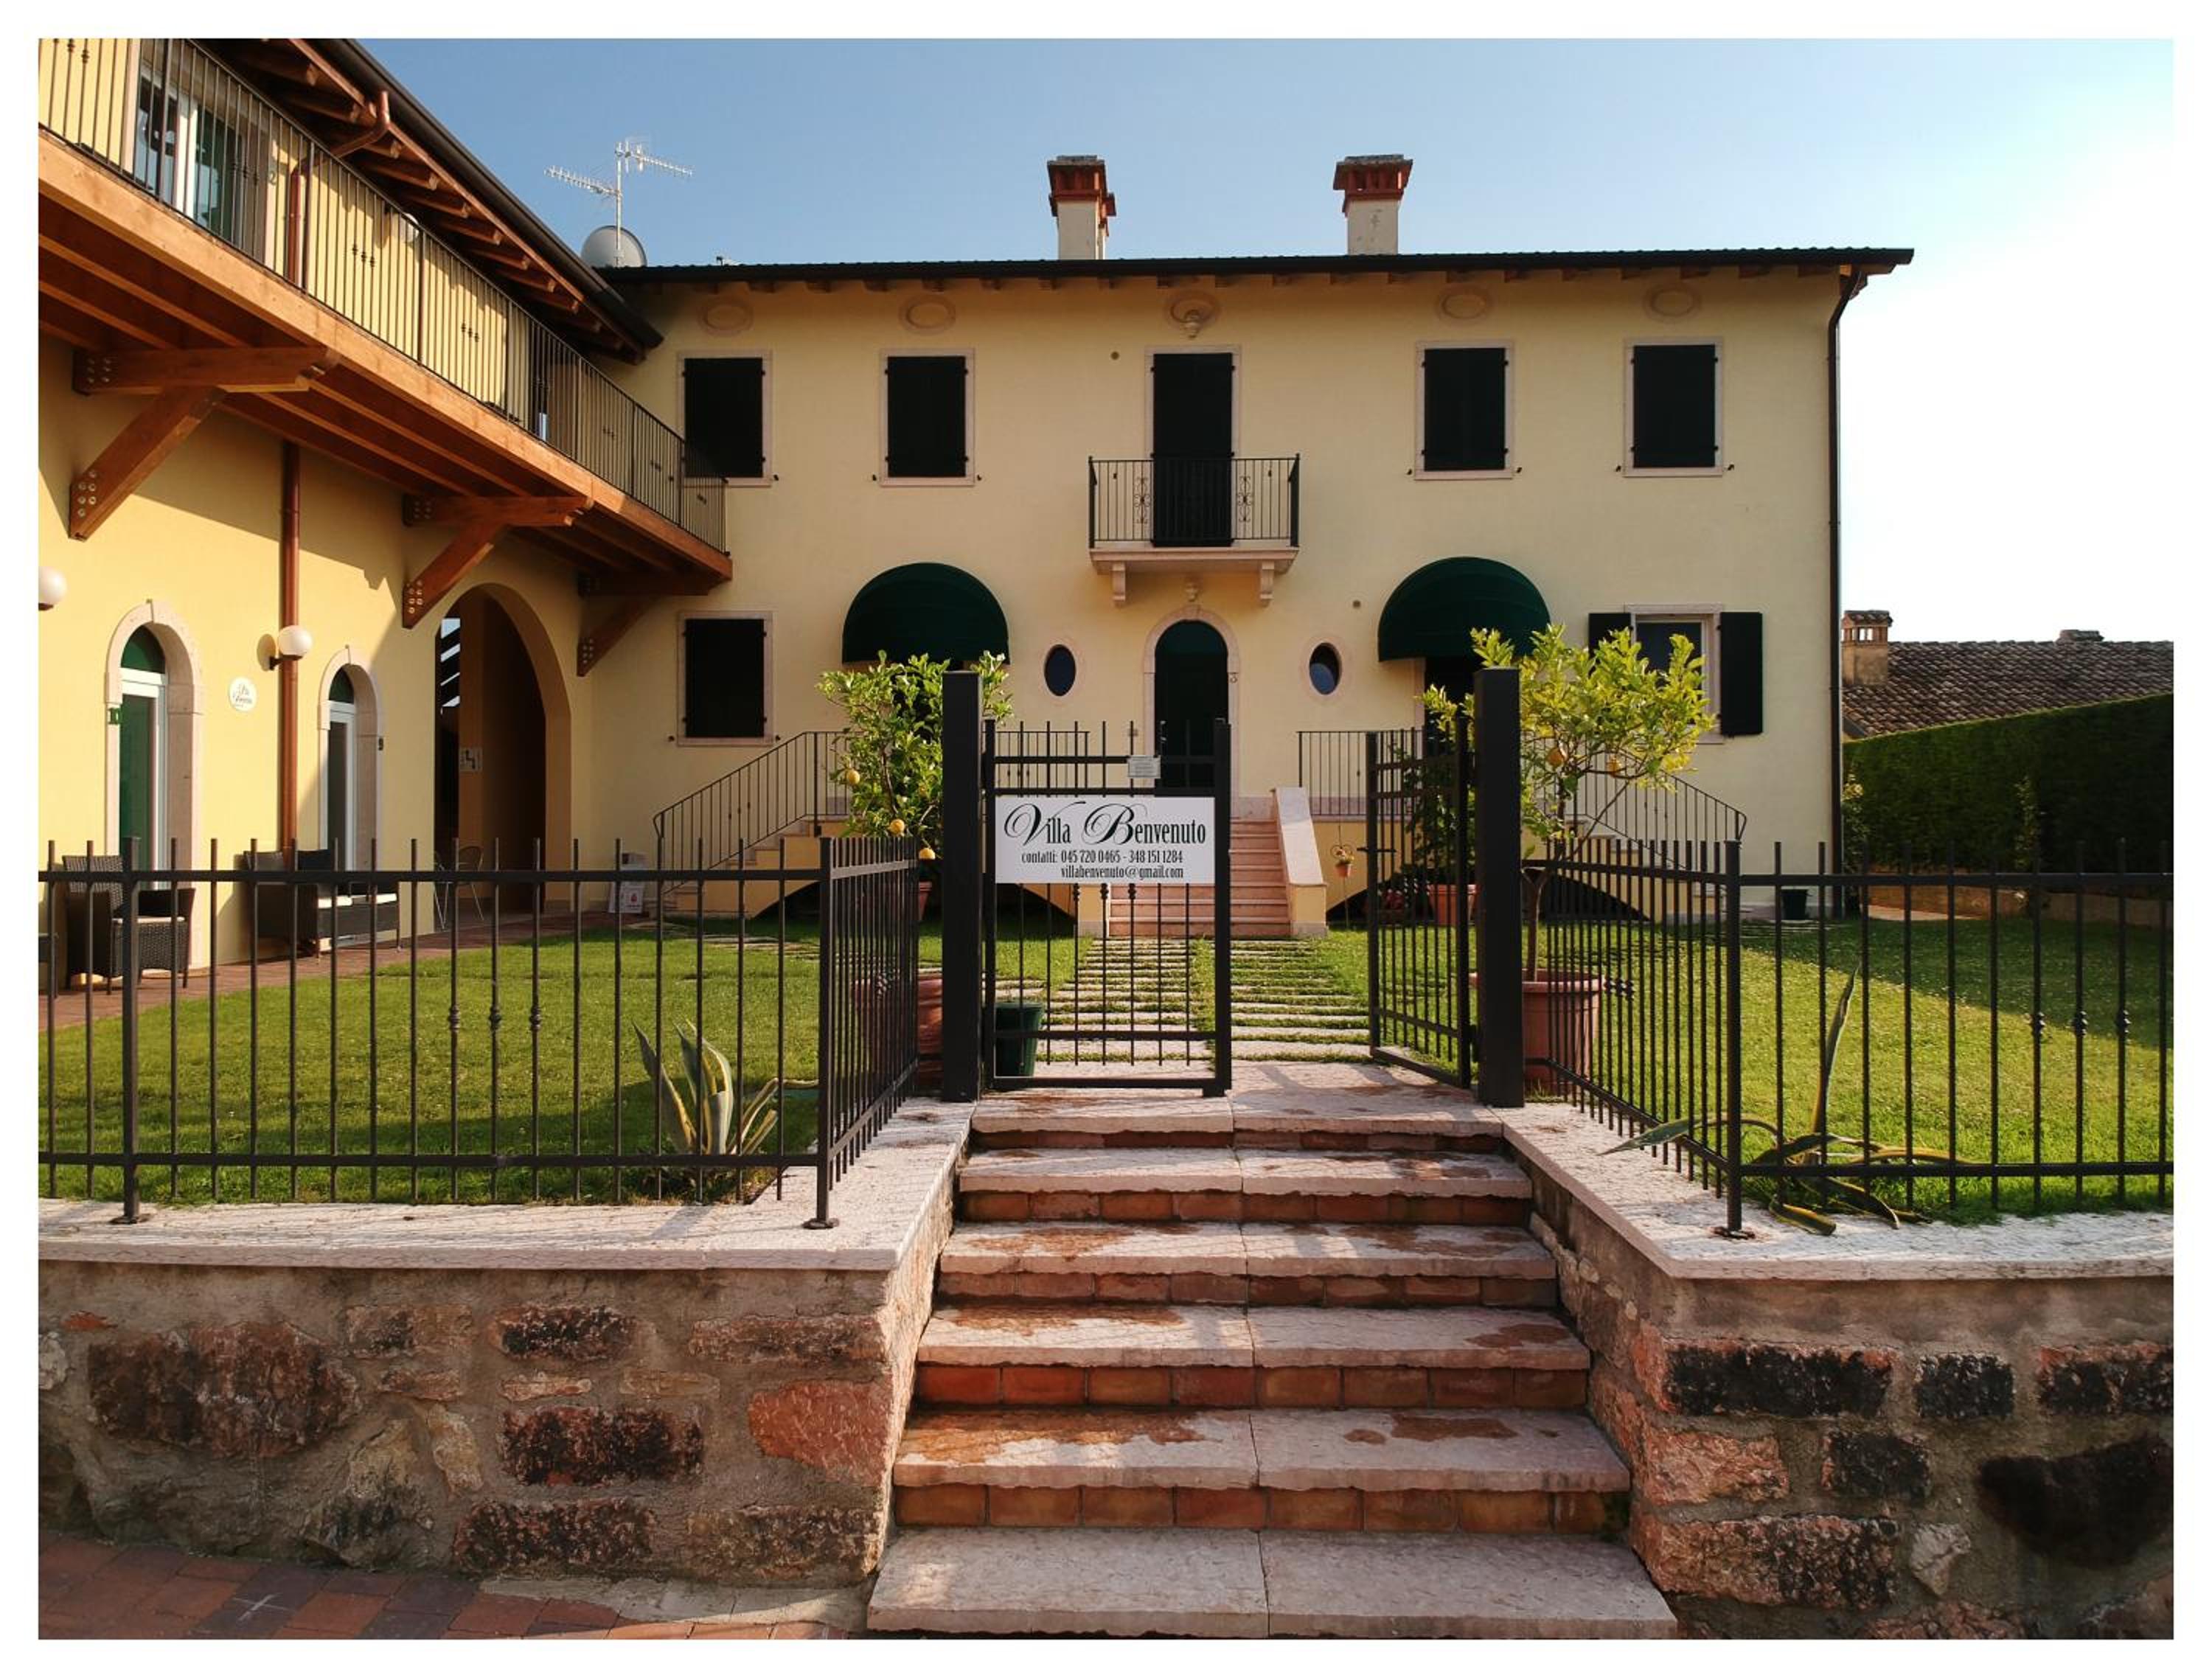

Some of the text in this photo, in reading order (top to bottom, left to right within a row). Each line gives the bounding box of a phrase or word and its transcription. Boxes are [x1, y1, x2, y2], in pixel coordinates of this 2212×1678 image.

[1004, 801, 1206, 846] Villa Benvenuto
[1021, 850, 1057, 863] contatti:
[1061, 849, 1077, 863] 045
[1079, 849, 1096, 863] 720
[1098, 849, 1121, 863] 0465
[1128, 849, 1146, 863] 348
[1147, 849, 1160, 863] 151
[1163, 849, 1183, 863] 1284
